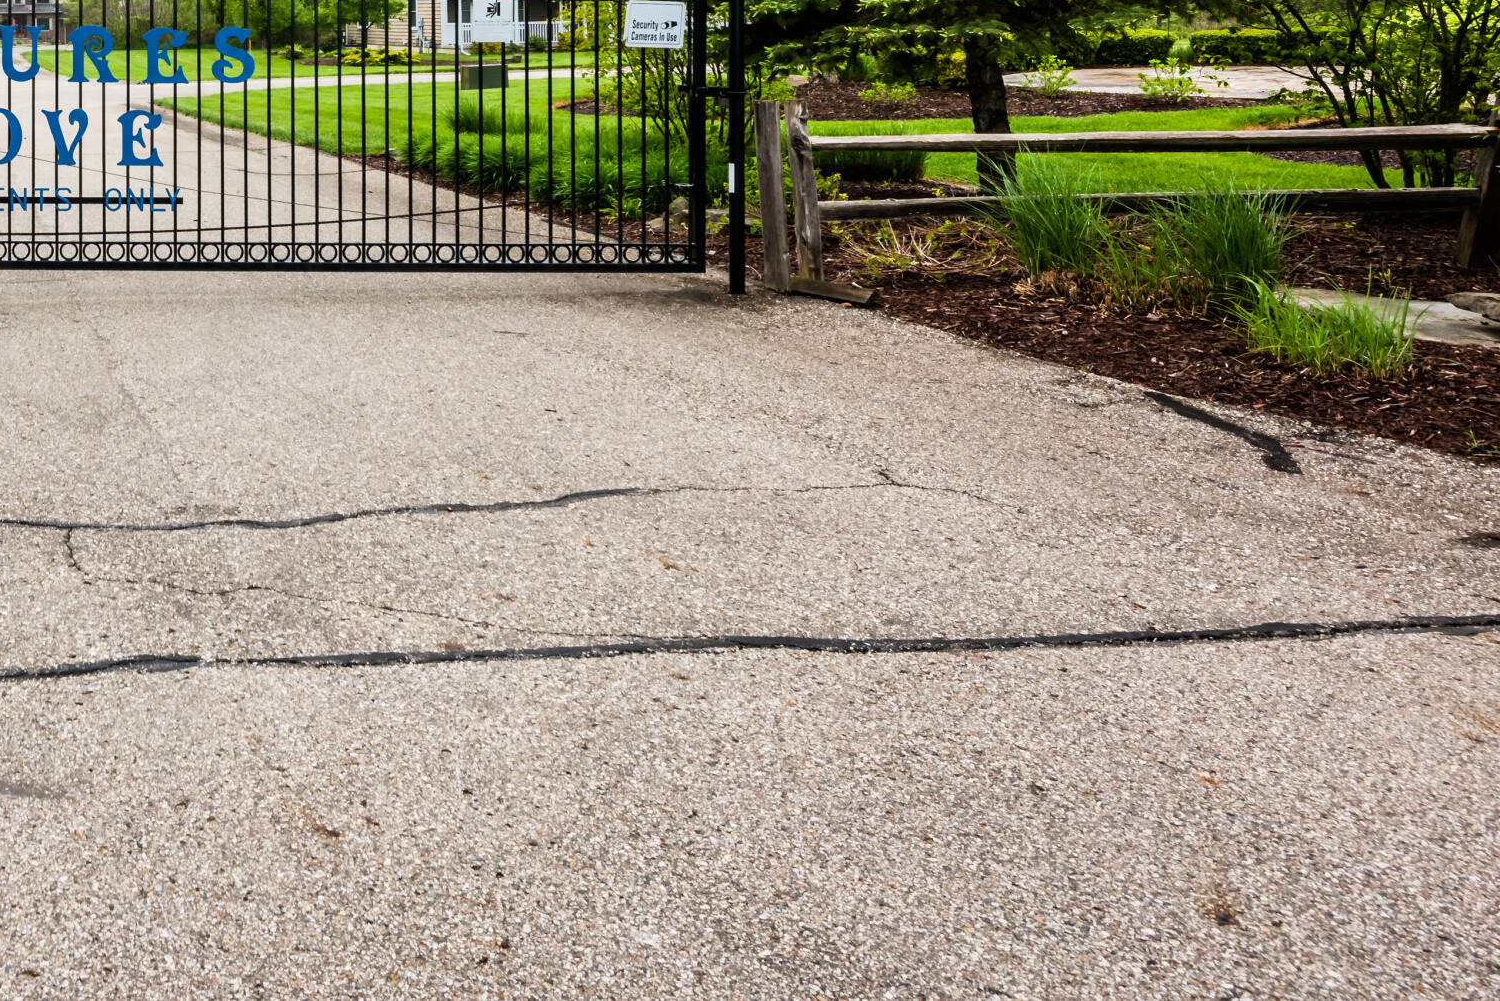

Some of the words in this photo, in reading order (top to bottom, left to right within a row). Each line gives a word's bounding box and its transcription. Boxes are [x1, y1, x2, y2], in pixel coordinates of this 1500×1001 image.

[632, 19, 659, 31] Security
[631, 31, 657, 41] Cameras
[667, 33, 678, 42] Use
[105, 187, 180, 212] ONLY
